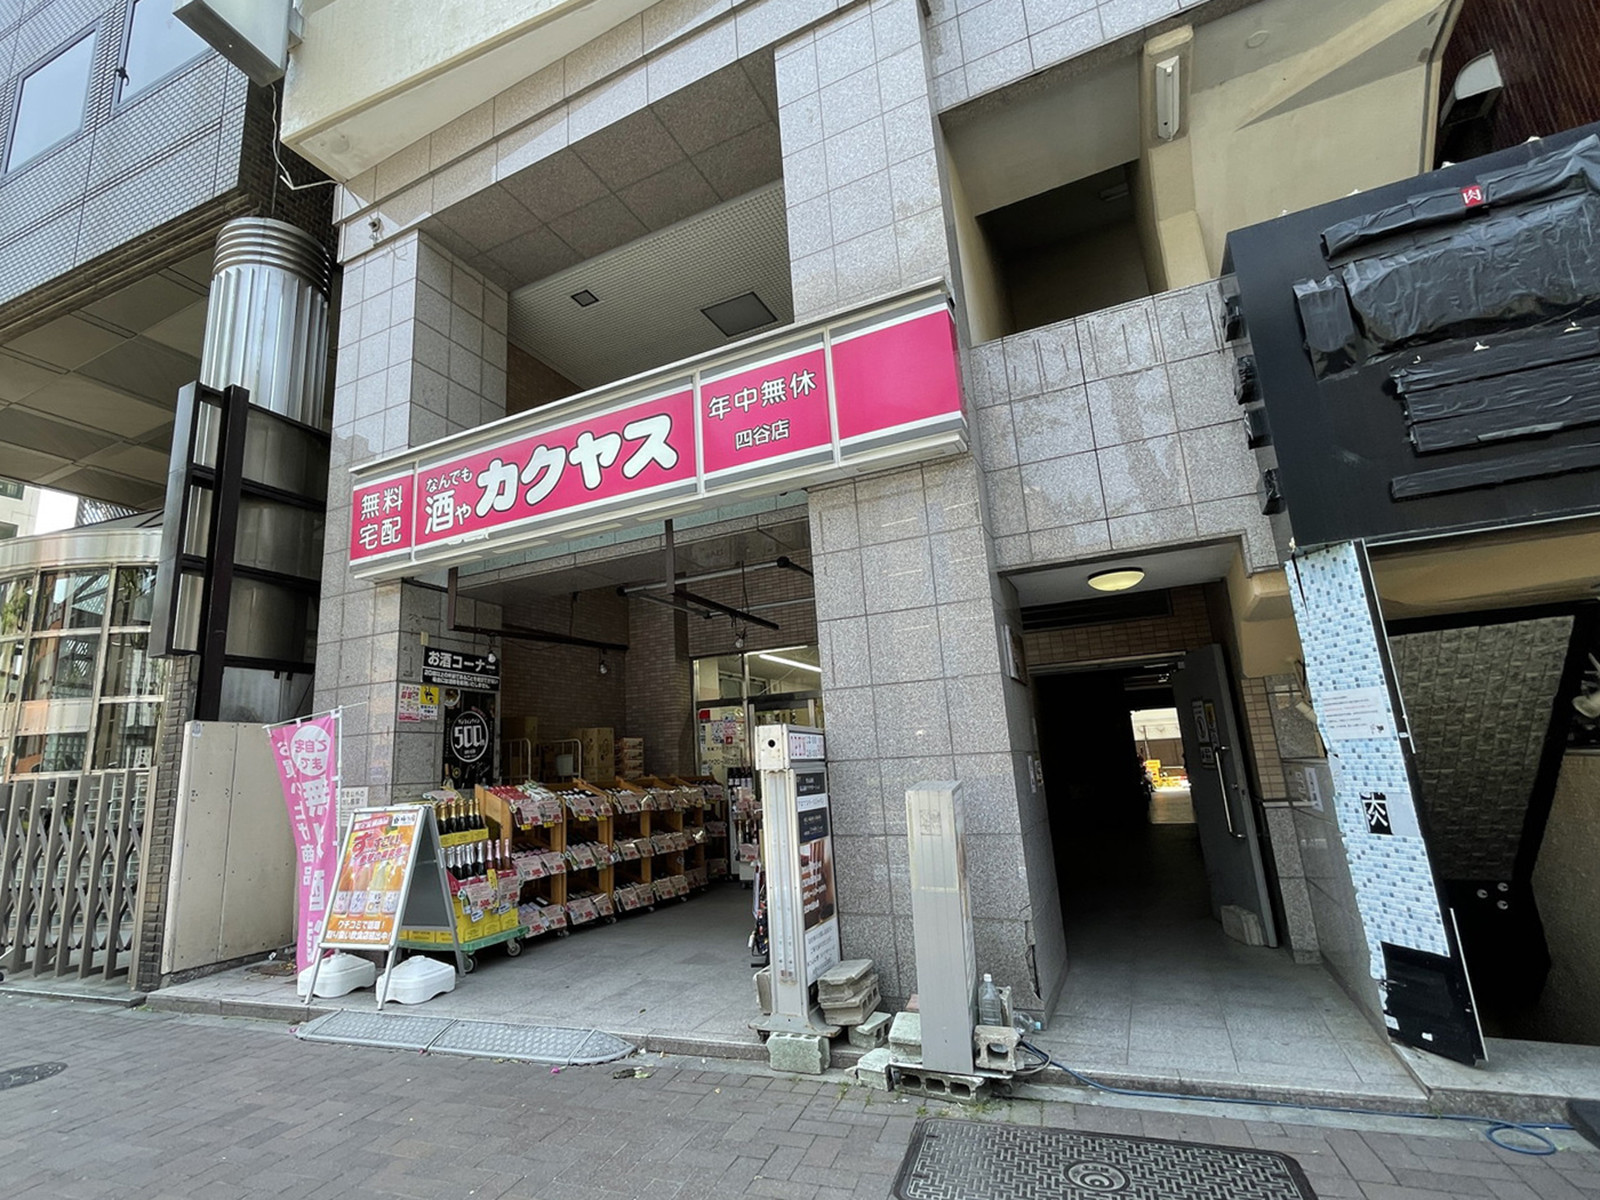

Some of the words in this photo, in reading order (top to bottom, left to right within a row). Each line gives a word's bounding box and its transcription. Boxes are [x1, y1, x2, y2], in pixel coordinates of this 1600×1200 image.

[1462, 189, 1482, 204] 肉
[708, 369, 816, 420] 年中無休
[735, 419, 790, 451] 四谷店
[426, 467, 473, 492] なんでも
[475, 413, 679, 518] カクヤス
[360, 485, 403, 521] 無料
[424, 489, 472, 535] 酒や
[359, 516, 402, 550] 宅配
[427, 651, 496, 672] お酒コーナー
